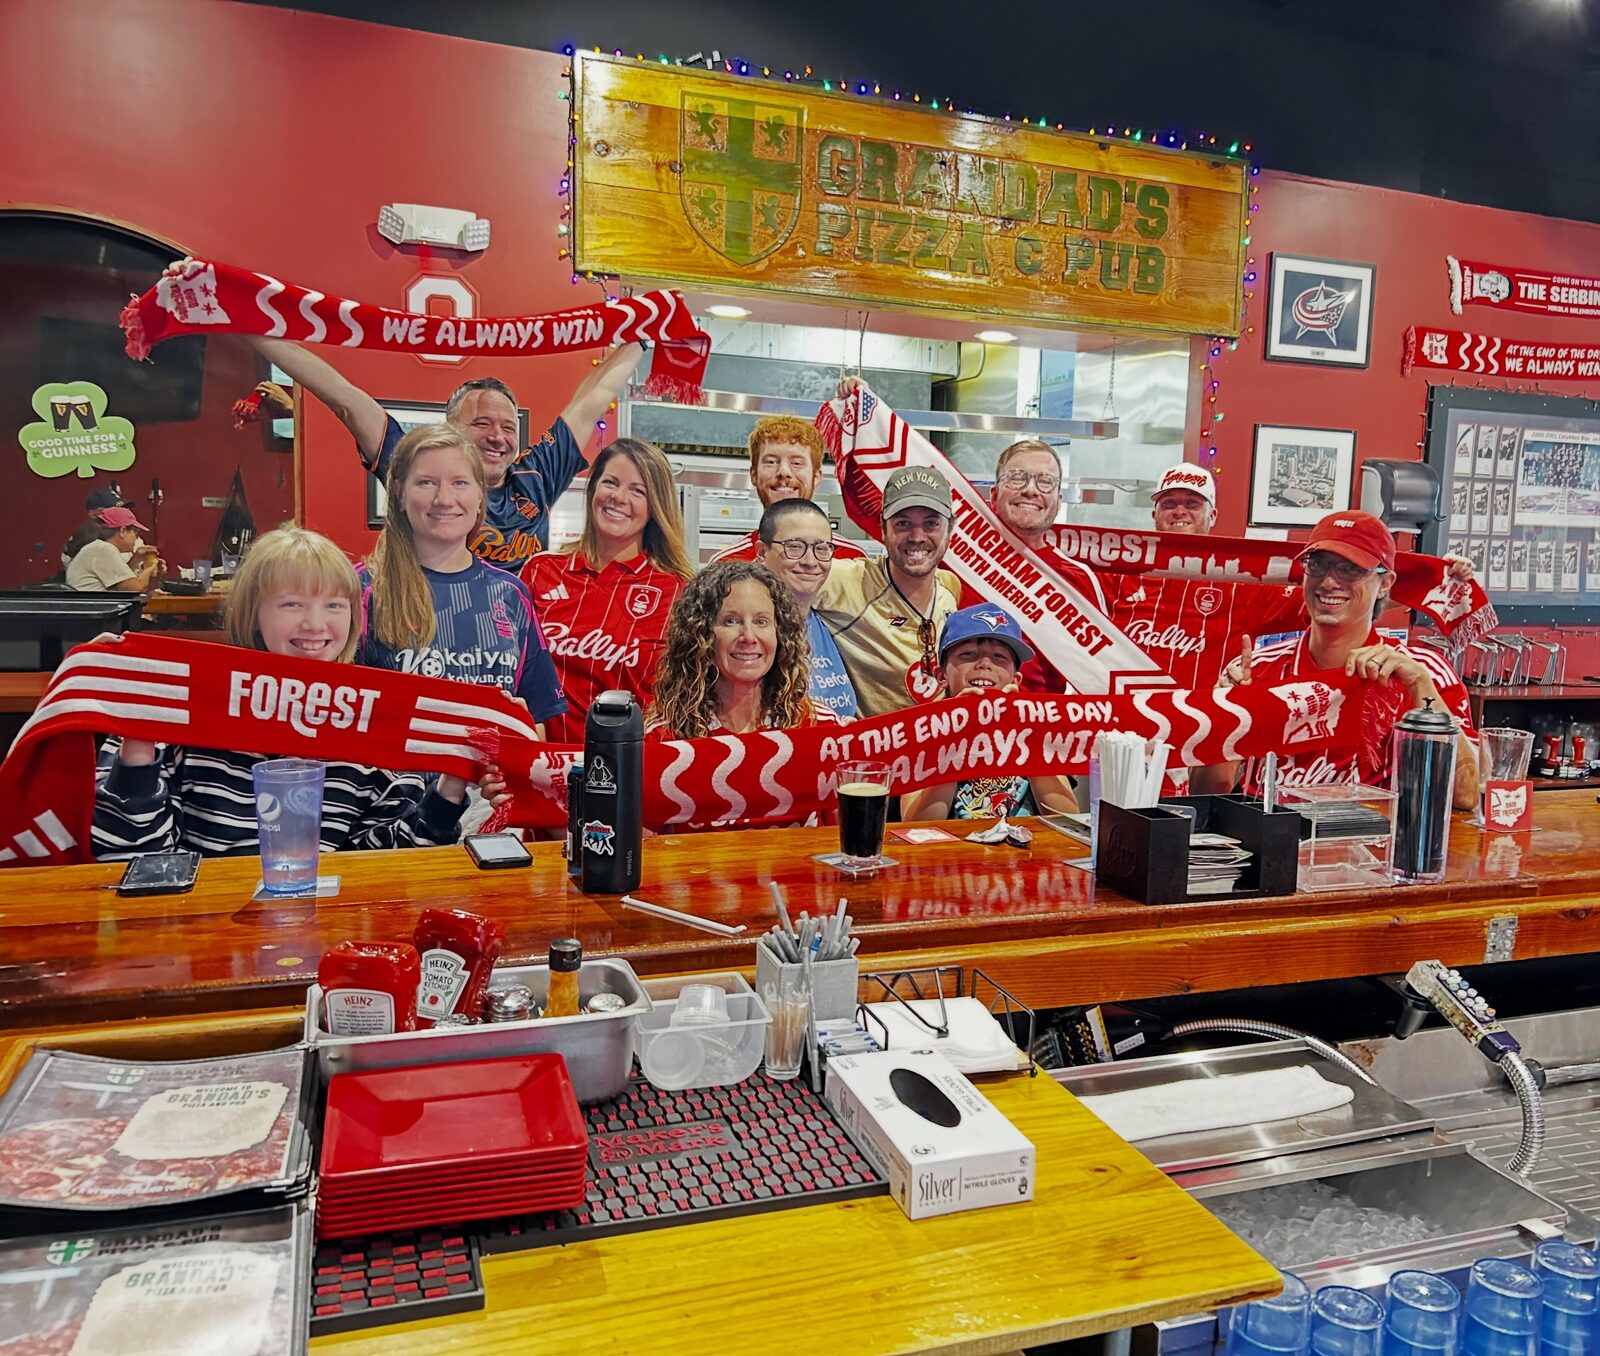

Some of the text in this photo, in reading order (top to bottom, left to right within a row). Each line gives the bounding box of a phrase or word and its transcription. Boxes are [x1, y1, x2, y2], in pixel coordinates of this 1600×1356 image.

[817, 134, 1171, 240] GRANDAD'S
[814, 202, 992, 275] PIZZA
[1062, 234, 1166, 295] PUB
[1518, 281, 1547, 301] THE
[382, 316, 604, 349] WE ALWAYS WIN
[1506, 344, 1519, 356] AT
[1519, 345, 1535, 357] THE
[1536, 346, 1556, 358] END
[1557, 348, 1569, 359] OF
[1570, 348, 1586, 360] THE
[1505, 357, 1523, 373] WE
[1526, 359, 1575, 377] ALWAYS
[28, 432, 126, 449] GOOD TIME FOR A
[42, 442, 118, 459] GUINNESS
[894, 471, 940, 490] NEW YORK
[948, 532, 1044, 624] NORTH AMERICA
[1035, 582, 1113, 656] FOREST
[541, 622, 640, 671] Bally's
[1123, 619, 1206, 658] Bally's
[444, 648, 518, 670] kaiyun
[820, 733, 855, 762] AT
[858, 722, 908, 757] THE
[914, 707, 969, 743] END
[978, 697, 1007, 726] OF
[1013, 699, 1062, 723] THE
[890, 728, 1033, 785] ALWAYS
[259, 823, 281, 833] pepsi
[430, 959, 455, 971] HEINZ
[424, 981, 451, 991] KETCHUP
[425, 972, 453, 985] TOMATO
[344, 995, 373, 1007] HEINZ
[594, 1123, 724, 1149] Maker's
[636, 1135, 729, 1157] Mark
[919, 1171, 956, 1201] Silver
[964, 1176, 1016, 1189] NITRILE GLOVES
